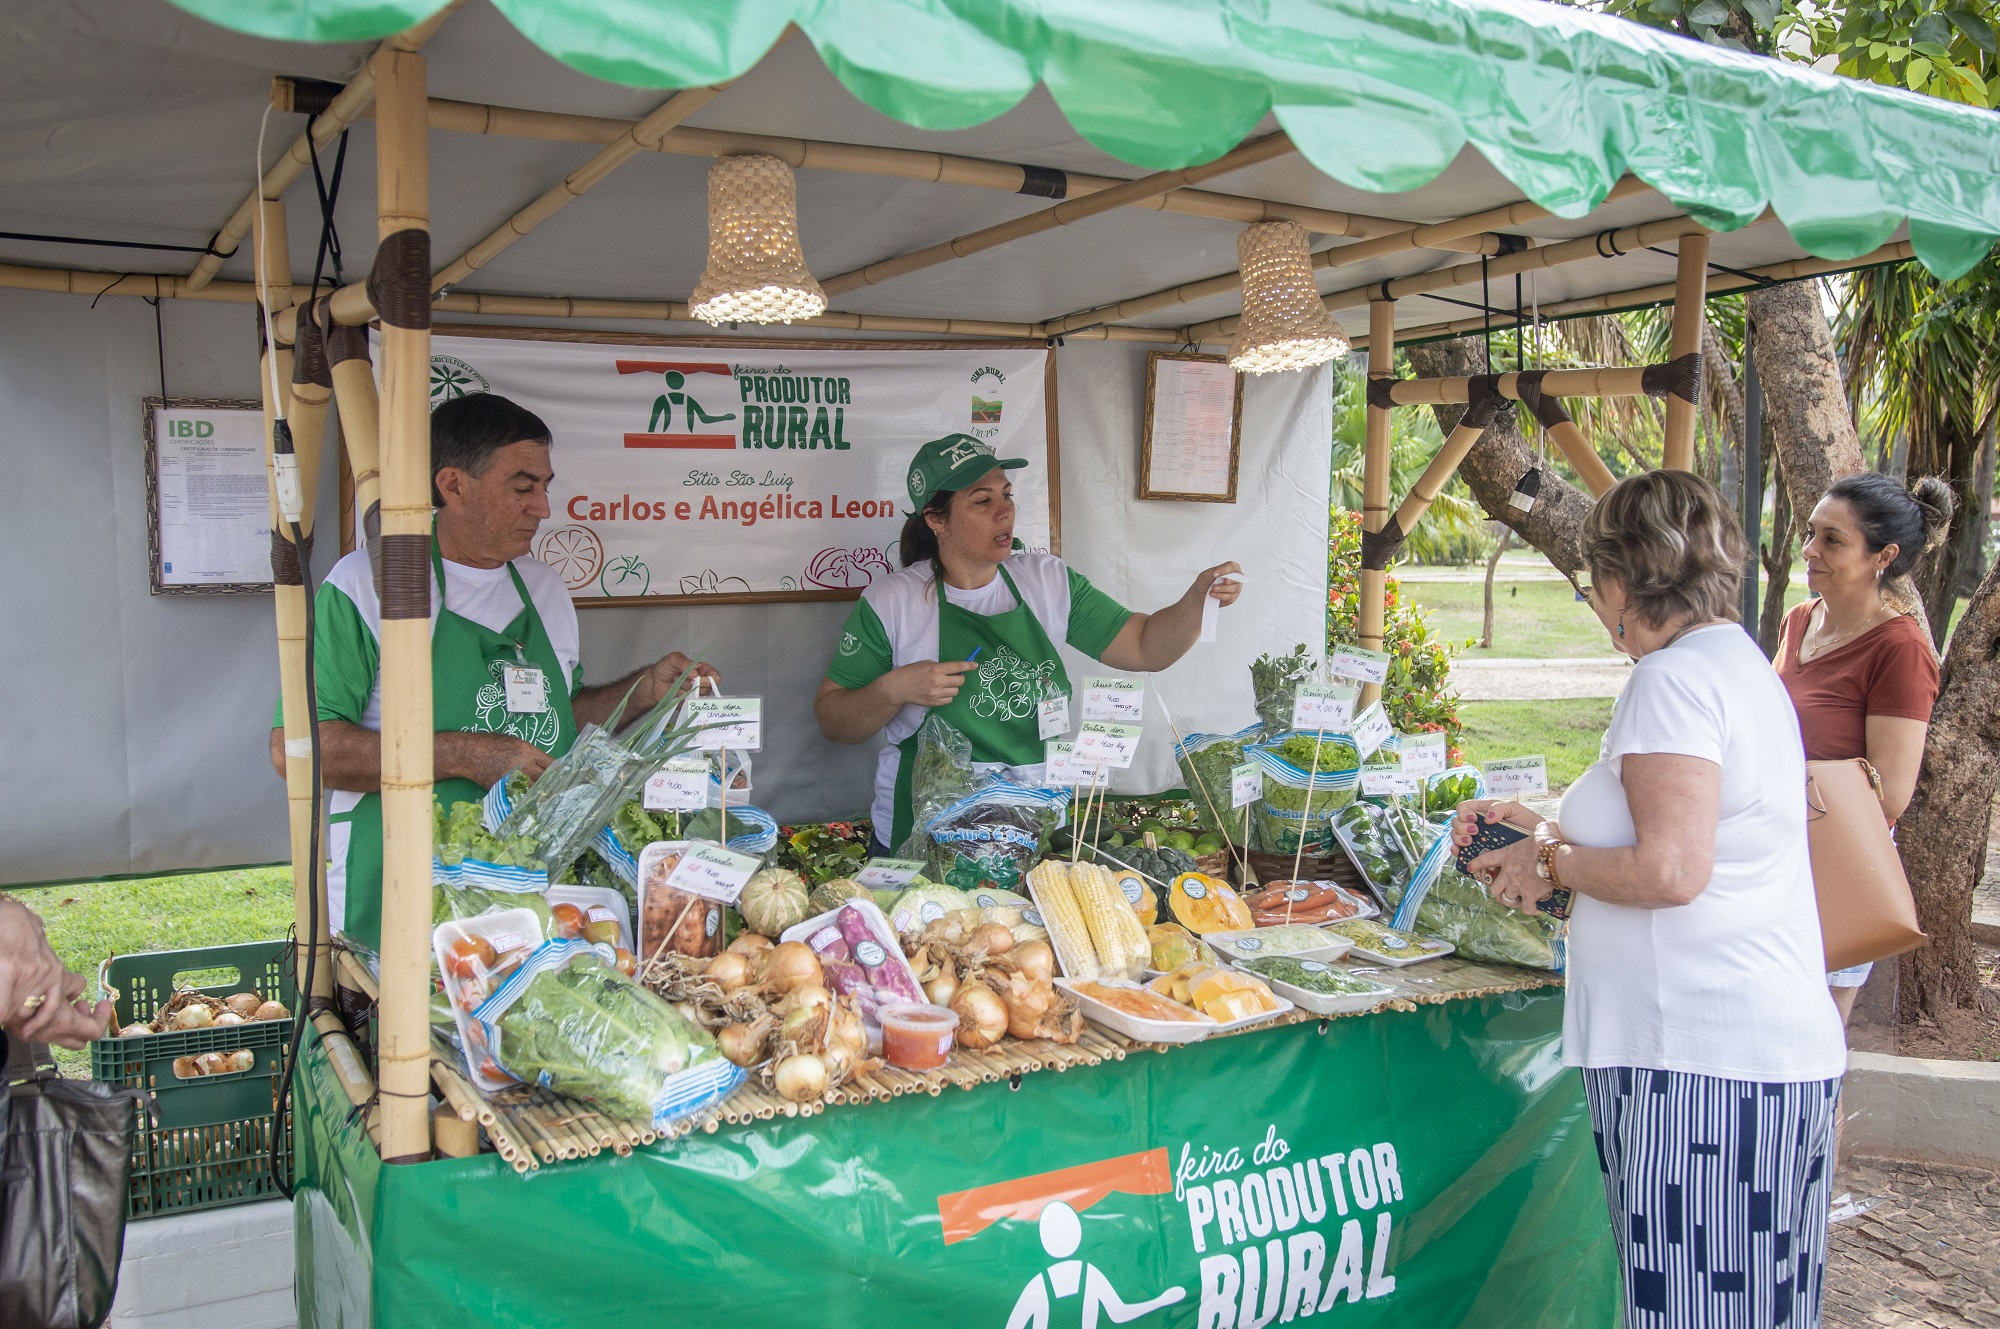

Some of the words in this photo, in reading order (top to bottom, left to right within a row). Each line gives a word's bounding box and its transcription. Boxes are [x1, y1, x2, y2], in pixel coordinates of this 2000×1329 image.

[734, 364, 769, 380] feira
[773, 364, 793, 374] do
[740, 376, 851, 404] PRODUTOR
[169, 420, 214, 438] IBD
[743, 405, 851, 450] RURAL
[683, 470, 721, 487] Sítio
[726, 470, 756, 487] São
[759, 470, 794, 492] Luiz
[567, 494, 666, 521] Carlos
[675, 502, 691, 521] e
[699, 494, 823, 527] Angélica
[832, 494, 894, 519] Leon
[1081, 770, 1096, 778] maç
[931, 828, 990, 845] Verdura
[1176, 1141, 1245, 1202] feira
[1253, 1123, 1291, 1166] do
[1186, 1142, 1404, 1253] PRODUTOR
[1198, 1212, 1396, 1329] RURAL
